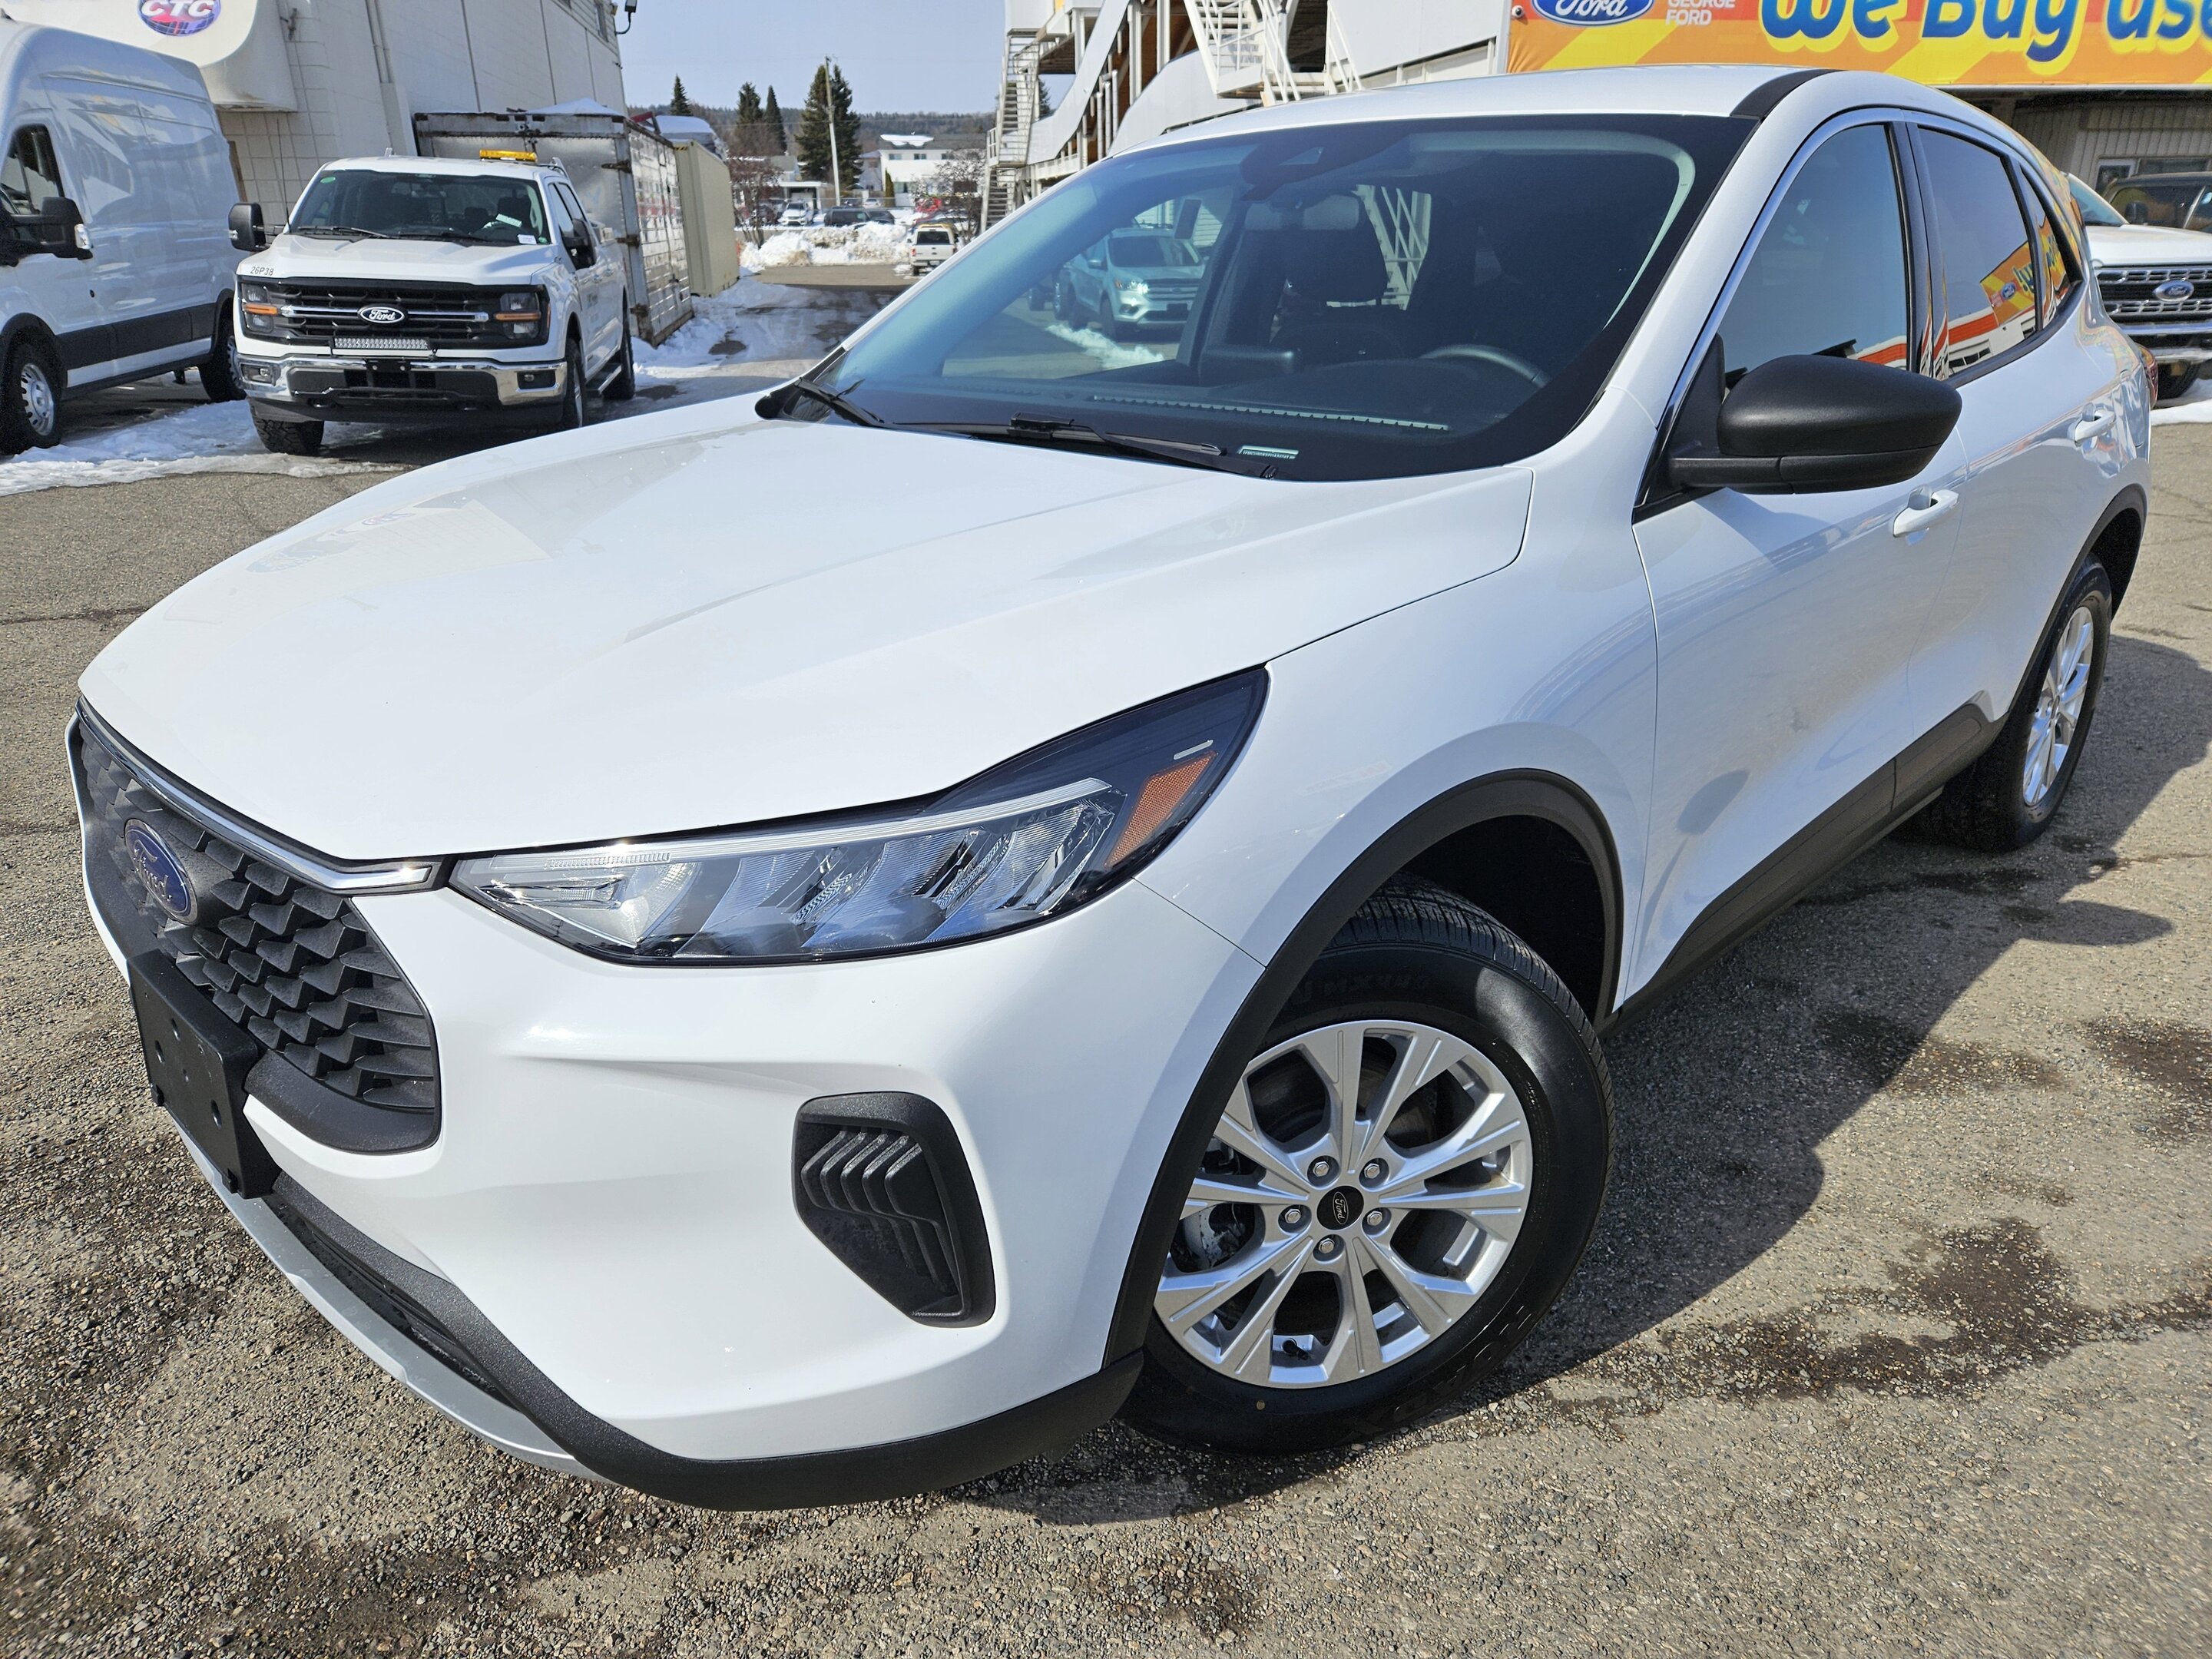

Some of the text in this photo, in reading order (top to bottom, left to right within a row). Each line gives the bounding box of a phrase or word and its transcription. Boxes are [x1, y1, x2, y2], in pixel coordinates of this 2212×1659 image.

[141, 0, 214, 17] CTC
[1665, 10, 1712, 25] FORD
[250, 266, 274, 276] 26P38
[369, 309, 396, 320] Ford
[1334, 1198, 1346, 1220] Ford
